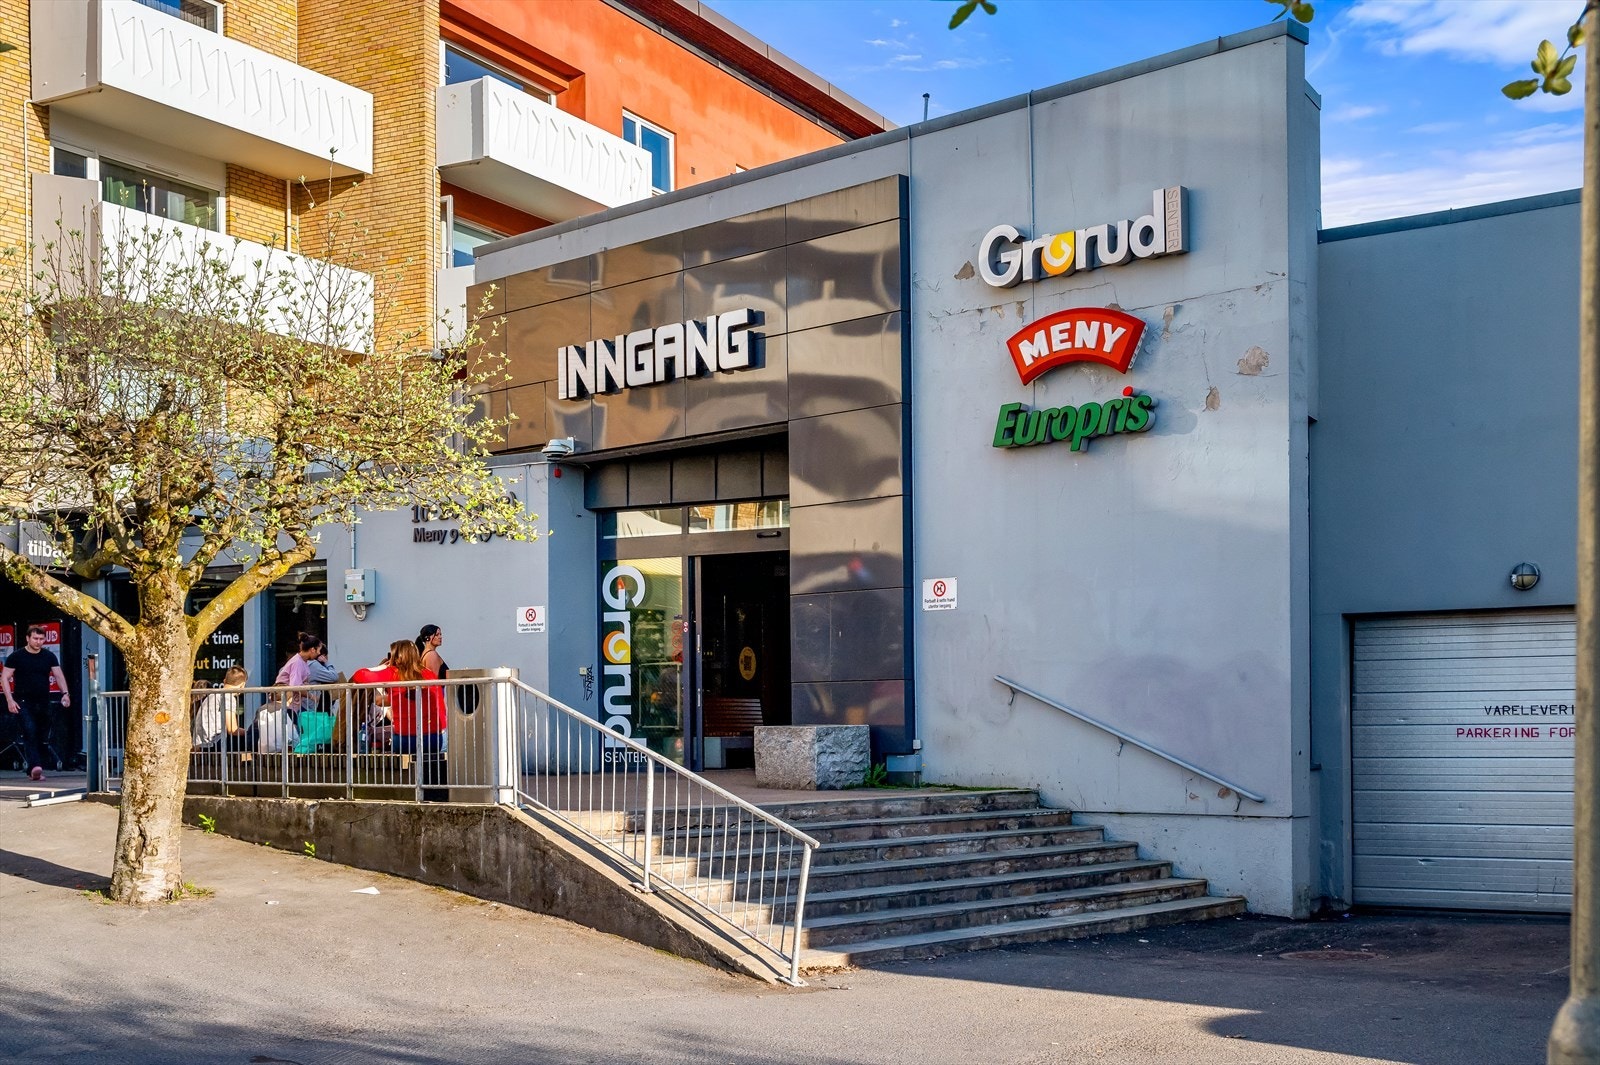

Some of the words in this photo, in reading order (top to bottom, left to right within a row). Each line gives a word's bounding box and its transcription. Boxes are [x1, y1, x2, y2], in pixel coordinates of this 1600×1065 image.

[1167, 189, 1179, 249] SENTER
[978, 188, 1166, 287] Grorud
[1018, 320, 1126, 367] MENY
[558, 308, 749, 400] INNGANG
[993, 386, 1153, 451] Europris
[413, 527, 447, 544] Meny
[27, 540, 65, 558] tilba
[212, 630, 243, 645] time.
[193, 657, 209, 669] ut
[212, 655, 236, 669] hair
[602, 565, 647, 748] Grorud
[1484, 704, 1576, 716] VARELEVERI
[1456, 727, 1540, 738] PARKERING
[1549, 727, 1577, 738] FOR
[604, 751, 648, 763] SENTER
